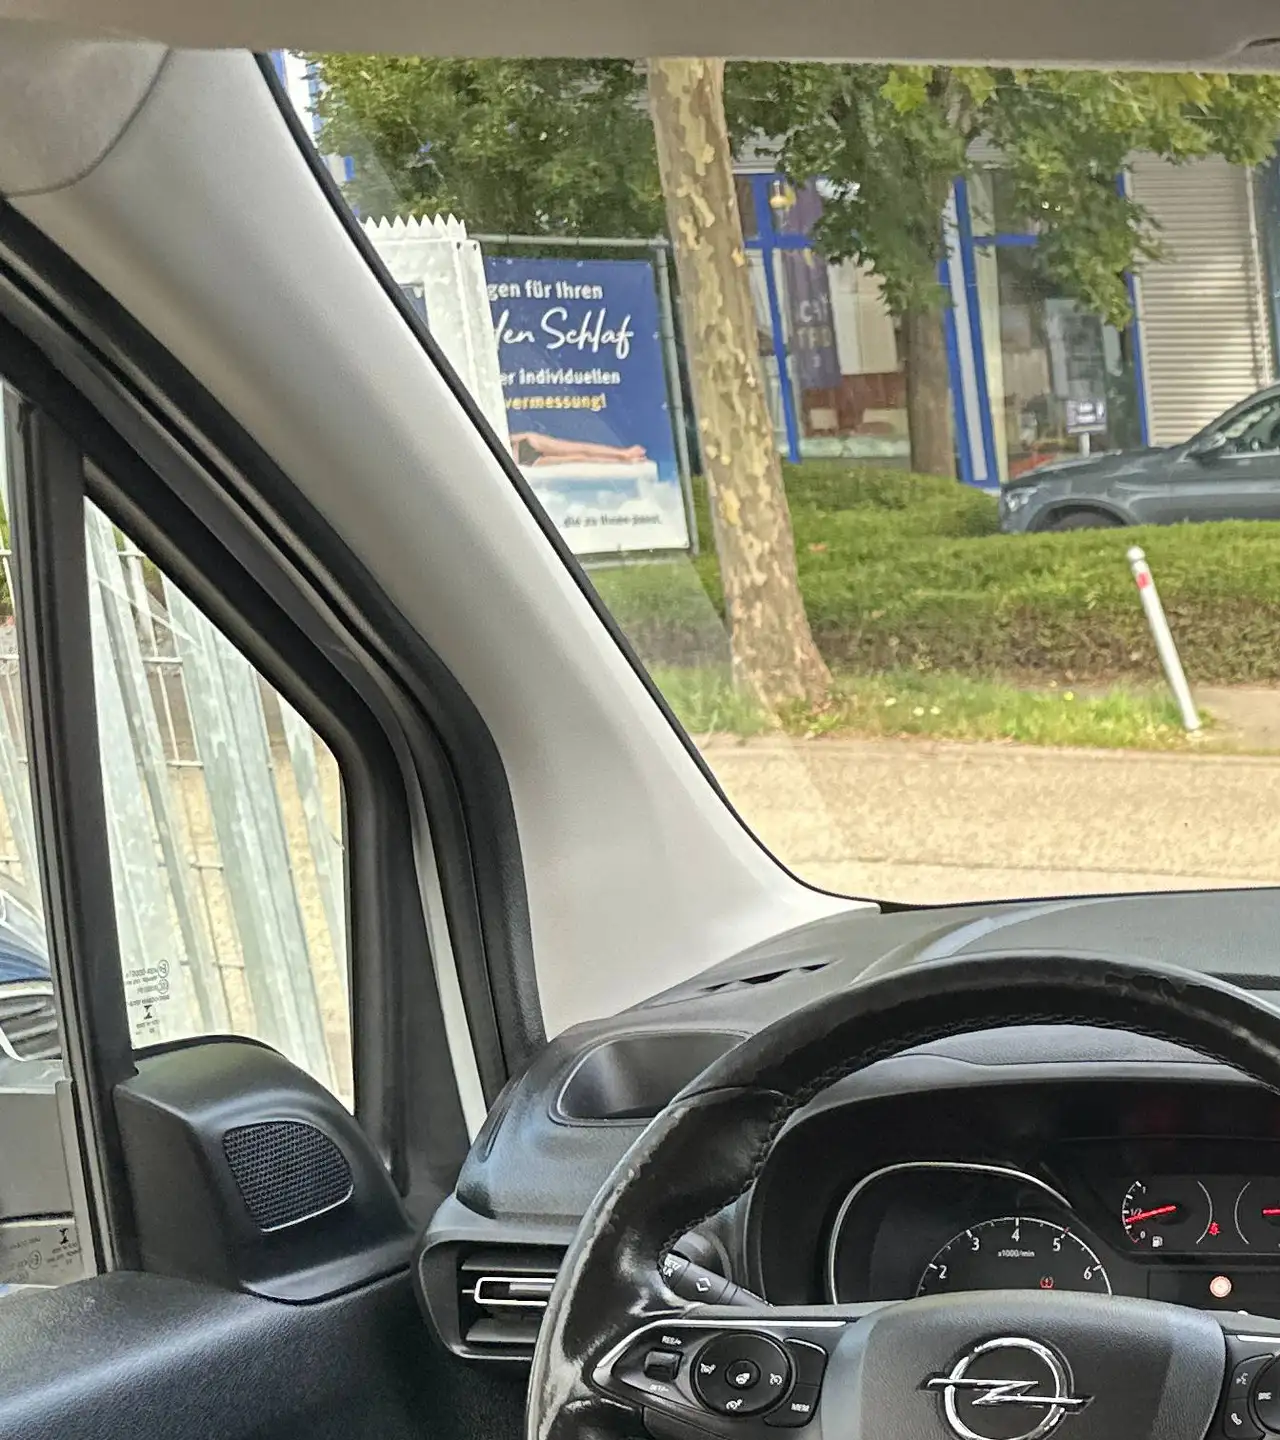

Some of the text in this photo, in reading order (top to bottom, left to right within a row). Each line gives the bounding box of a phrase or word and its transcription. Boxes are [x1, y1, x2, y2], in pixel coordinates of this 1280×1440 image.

[525, 279, 551, 299] für
[556, 280, 603, 300] Ihren
[540, 306, 635, 360] Schlaf
[1011, 1228, 1020, 1242] 4
[972, 1238, 980, 1251] 3
[1052, 1238, 1061, 1251] 5
[939, 1265, 947, 1280] 2
[1083, 1266, 1092, 1280] 6
